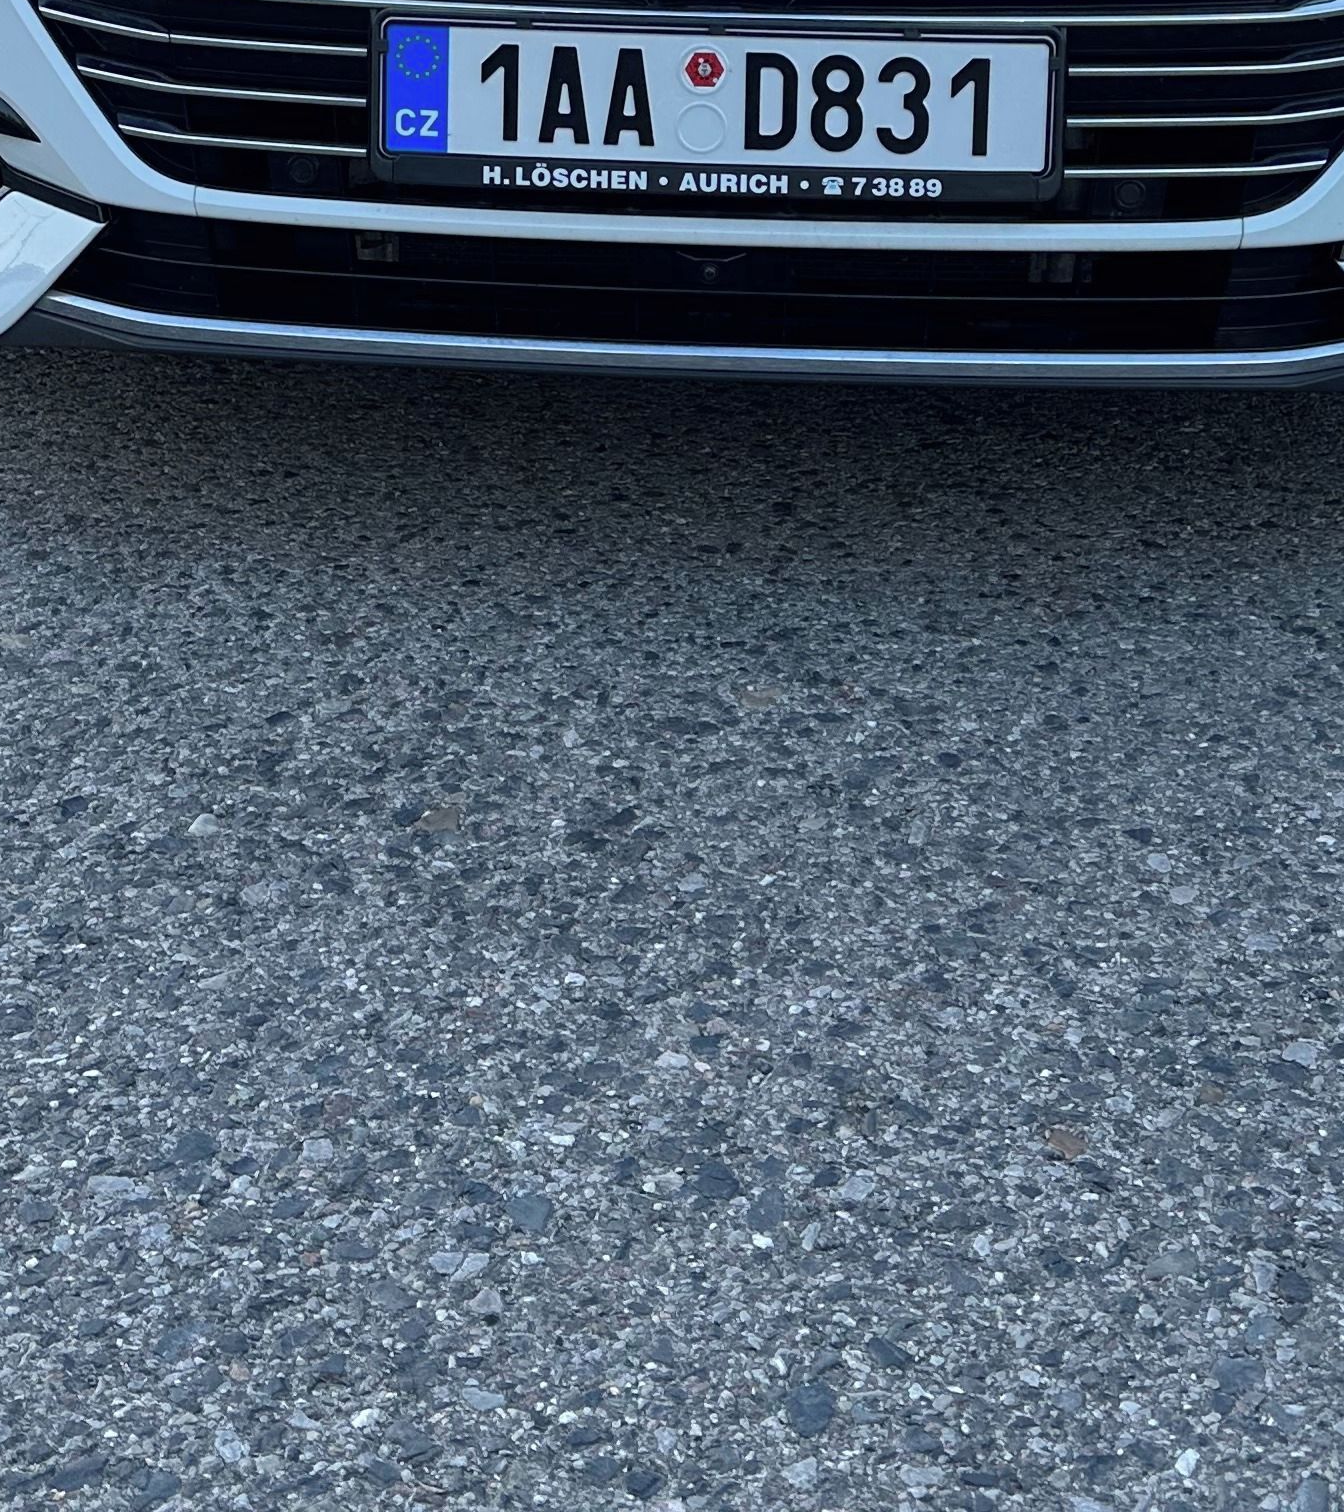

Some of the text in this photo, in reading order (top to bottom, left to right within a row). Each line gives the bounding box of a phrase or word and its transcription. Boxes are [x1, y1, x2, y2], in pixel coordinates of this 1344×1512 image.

[480, 43, 992, 157] 1AA D831
[394, 106, 440, 138] CZ
[678, 172, 789, 194] AURICH
